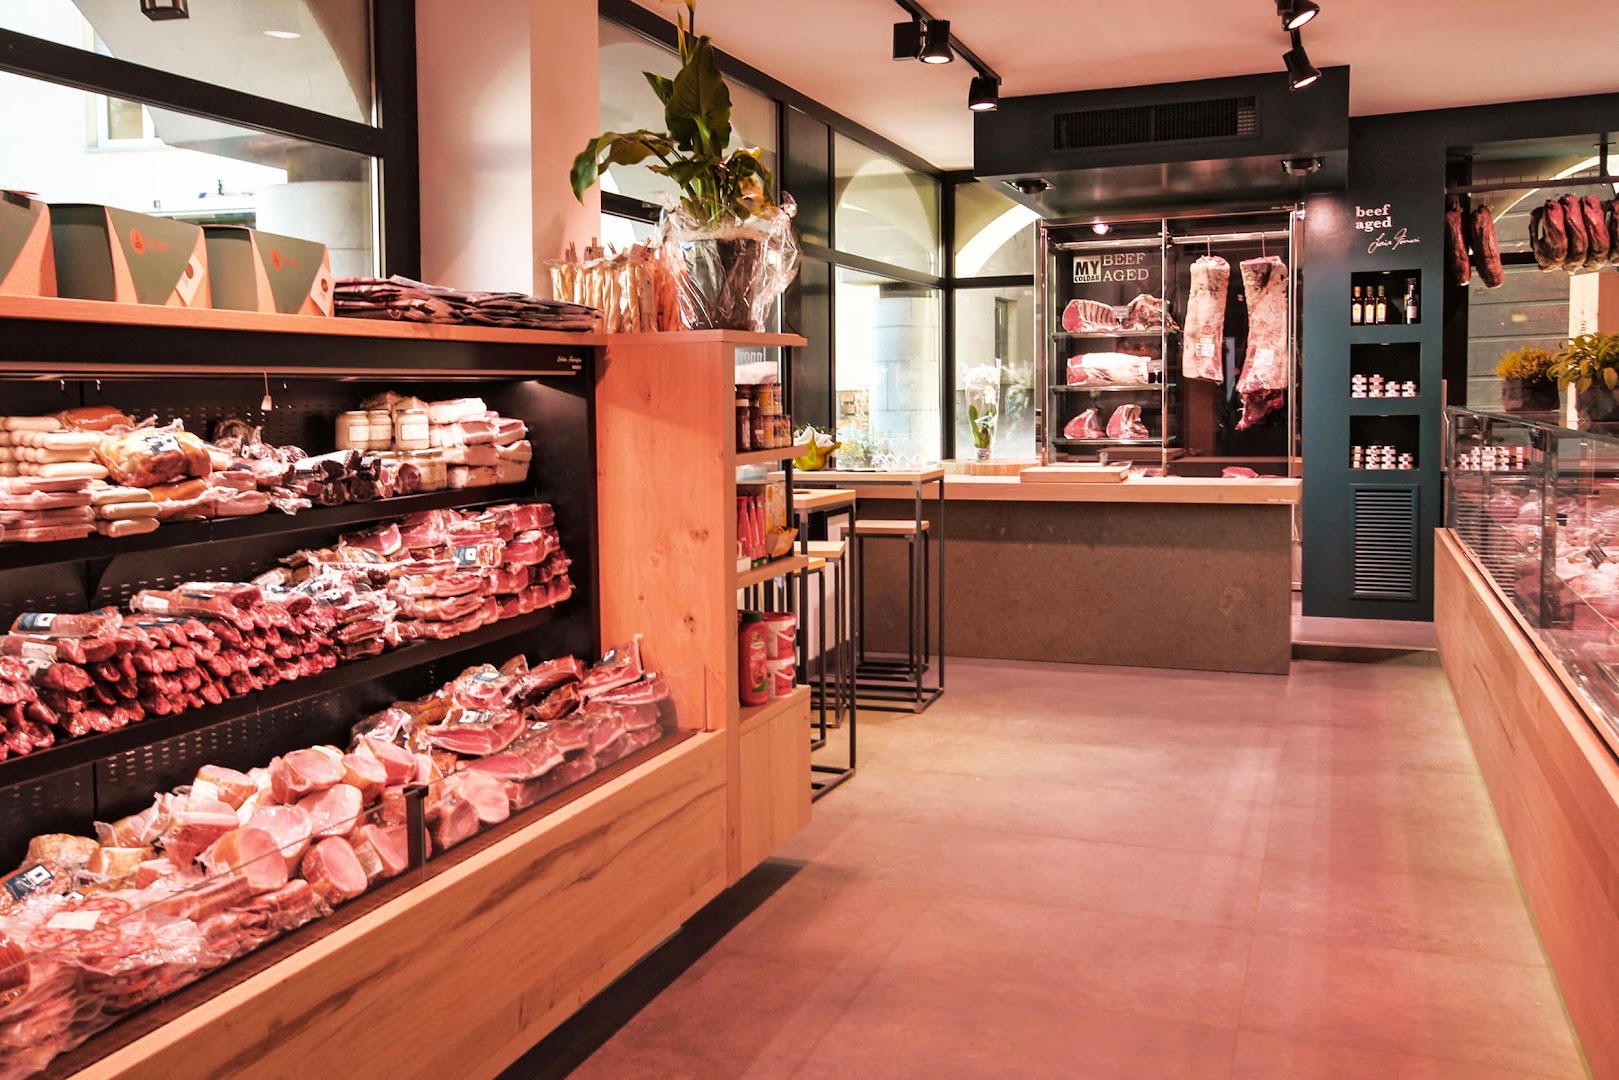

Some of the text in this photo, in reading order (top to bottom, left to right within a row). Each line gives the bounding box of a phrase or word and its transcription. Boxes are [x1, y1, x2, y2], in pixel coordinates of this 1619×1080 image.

[1355, 204, 1391, 217] beef
[1355, 216, 1392, 232] aged
[1102, 253, 1146, 266] BEEF
[1075, 260, 1099, 275] MY
[1102, 268, 1149, 282] AGED
